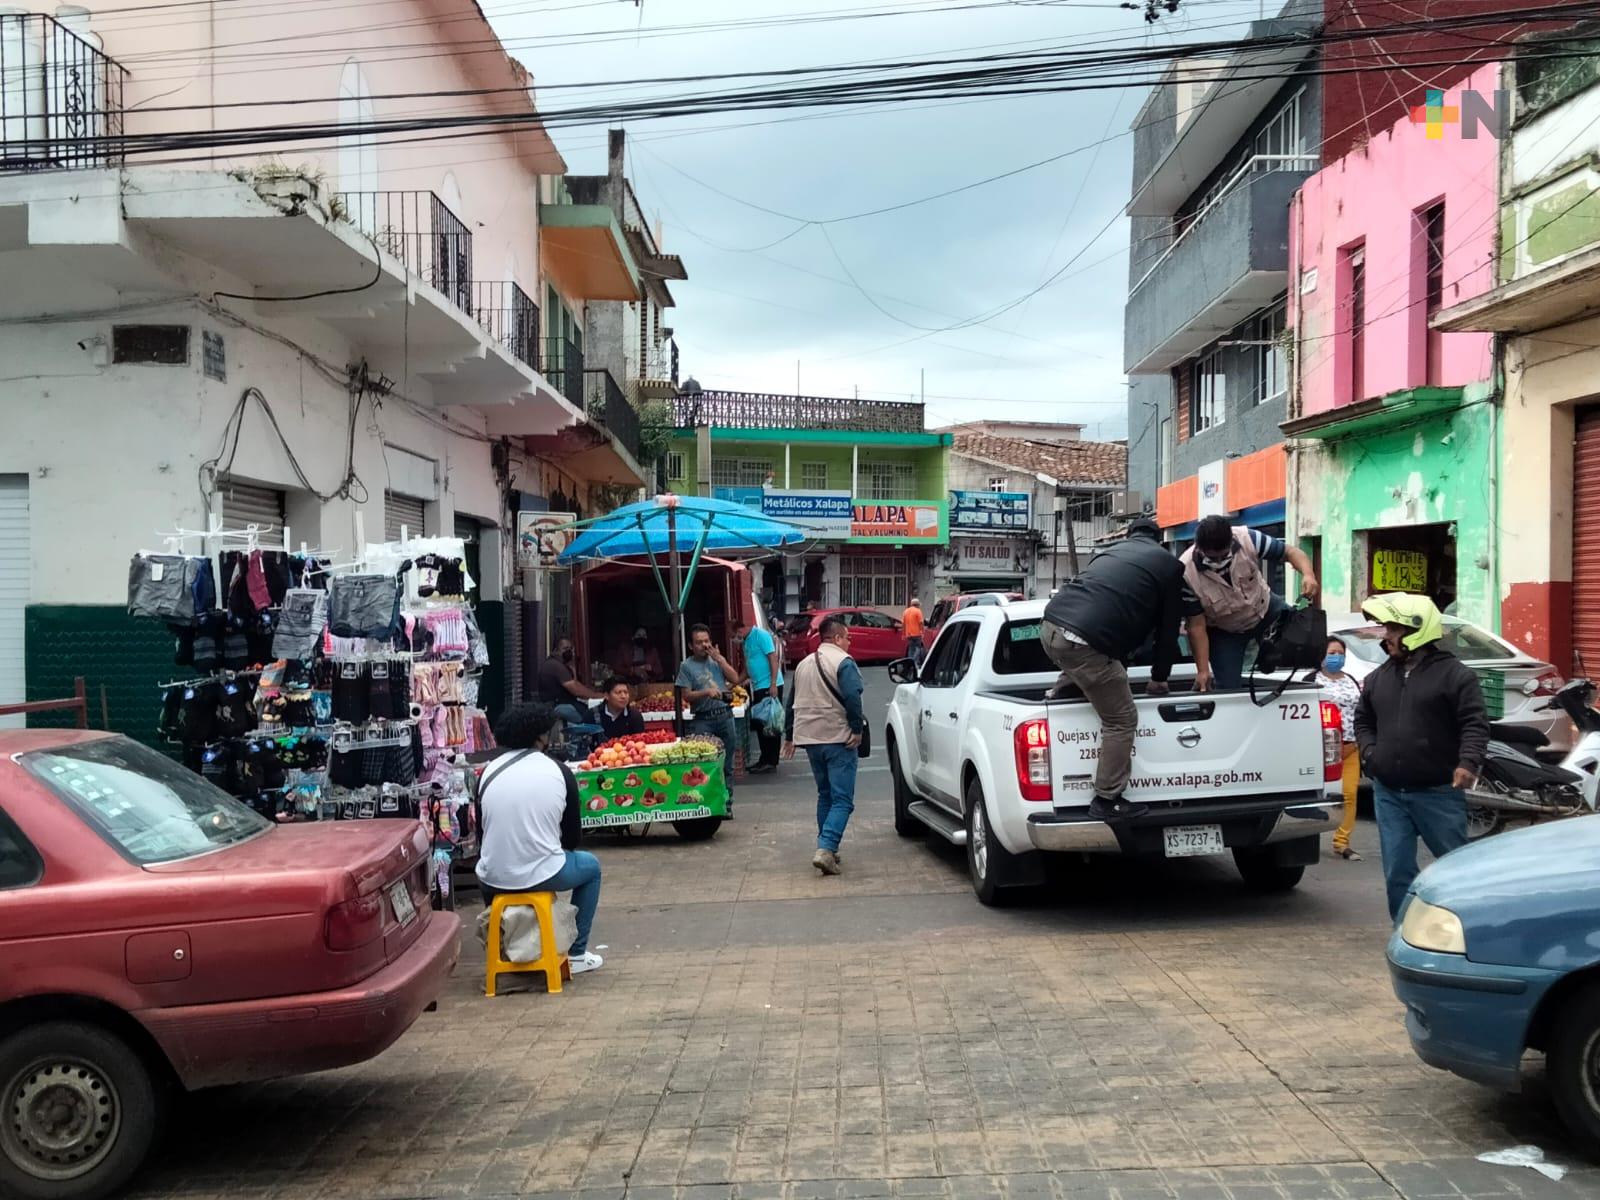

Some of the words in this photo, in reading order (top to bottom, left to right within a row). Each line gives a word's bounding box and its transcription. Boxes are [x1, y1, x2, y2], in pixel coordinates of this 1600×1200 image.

[763, 497, 813, 508] Metálicos
[815, 499, 849, 511] Xalapa
[964, 546, 975, 558] TU
[978, 546, 1010, 559] SALUD
[1279, 703, 1311, 720] 722
[1057, 729, 1090, 744] Quejas
[1092, 731, 1098, 743] y
[1299, 767, 1315, 776] LE
[1129, 771, 1263, 789] www.xalapa.gob.mx
[603, 813, 633, 826] Finas
[635, 811, 651, 822] De
[652, 806, 711, 821] Temporada
[1166, 831, 1222, 848] XS-7237-A
